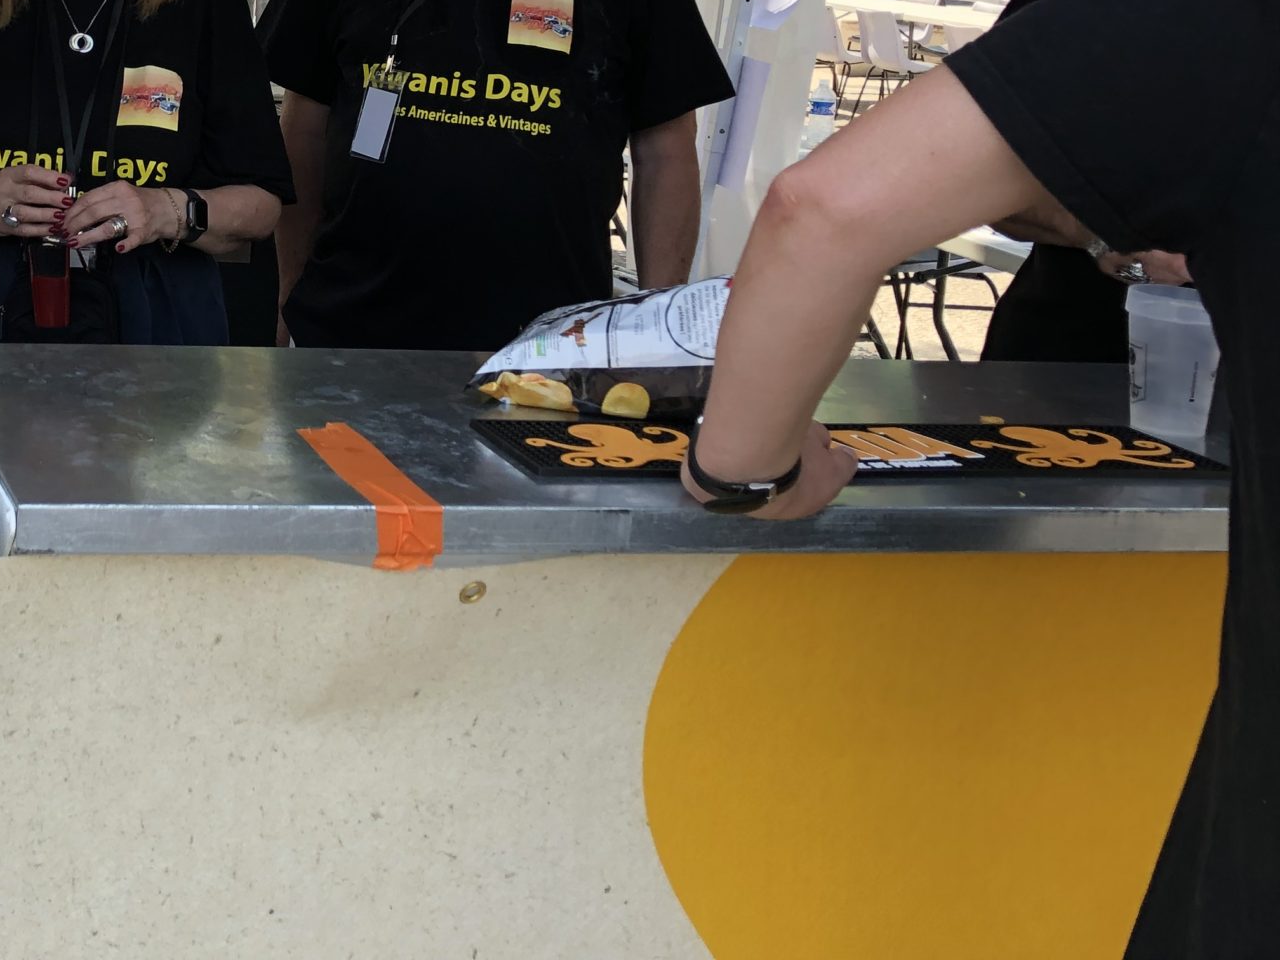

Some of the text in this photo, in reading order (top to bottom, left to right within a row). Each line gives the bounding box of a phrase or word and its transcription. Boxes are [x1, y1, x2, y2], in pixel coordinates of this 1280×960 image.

[362, 62, 562, 113] Kiwanis Days
[408, 105, 484, 127] Americaines
[486, 114, 498, 128] &
[499, 114, 552, 136] Vintages
